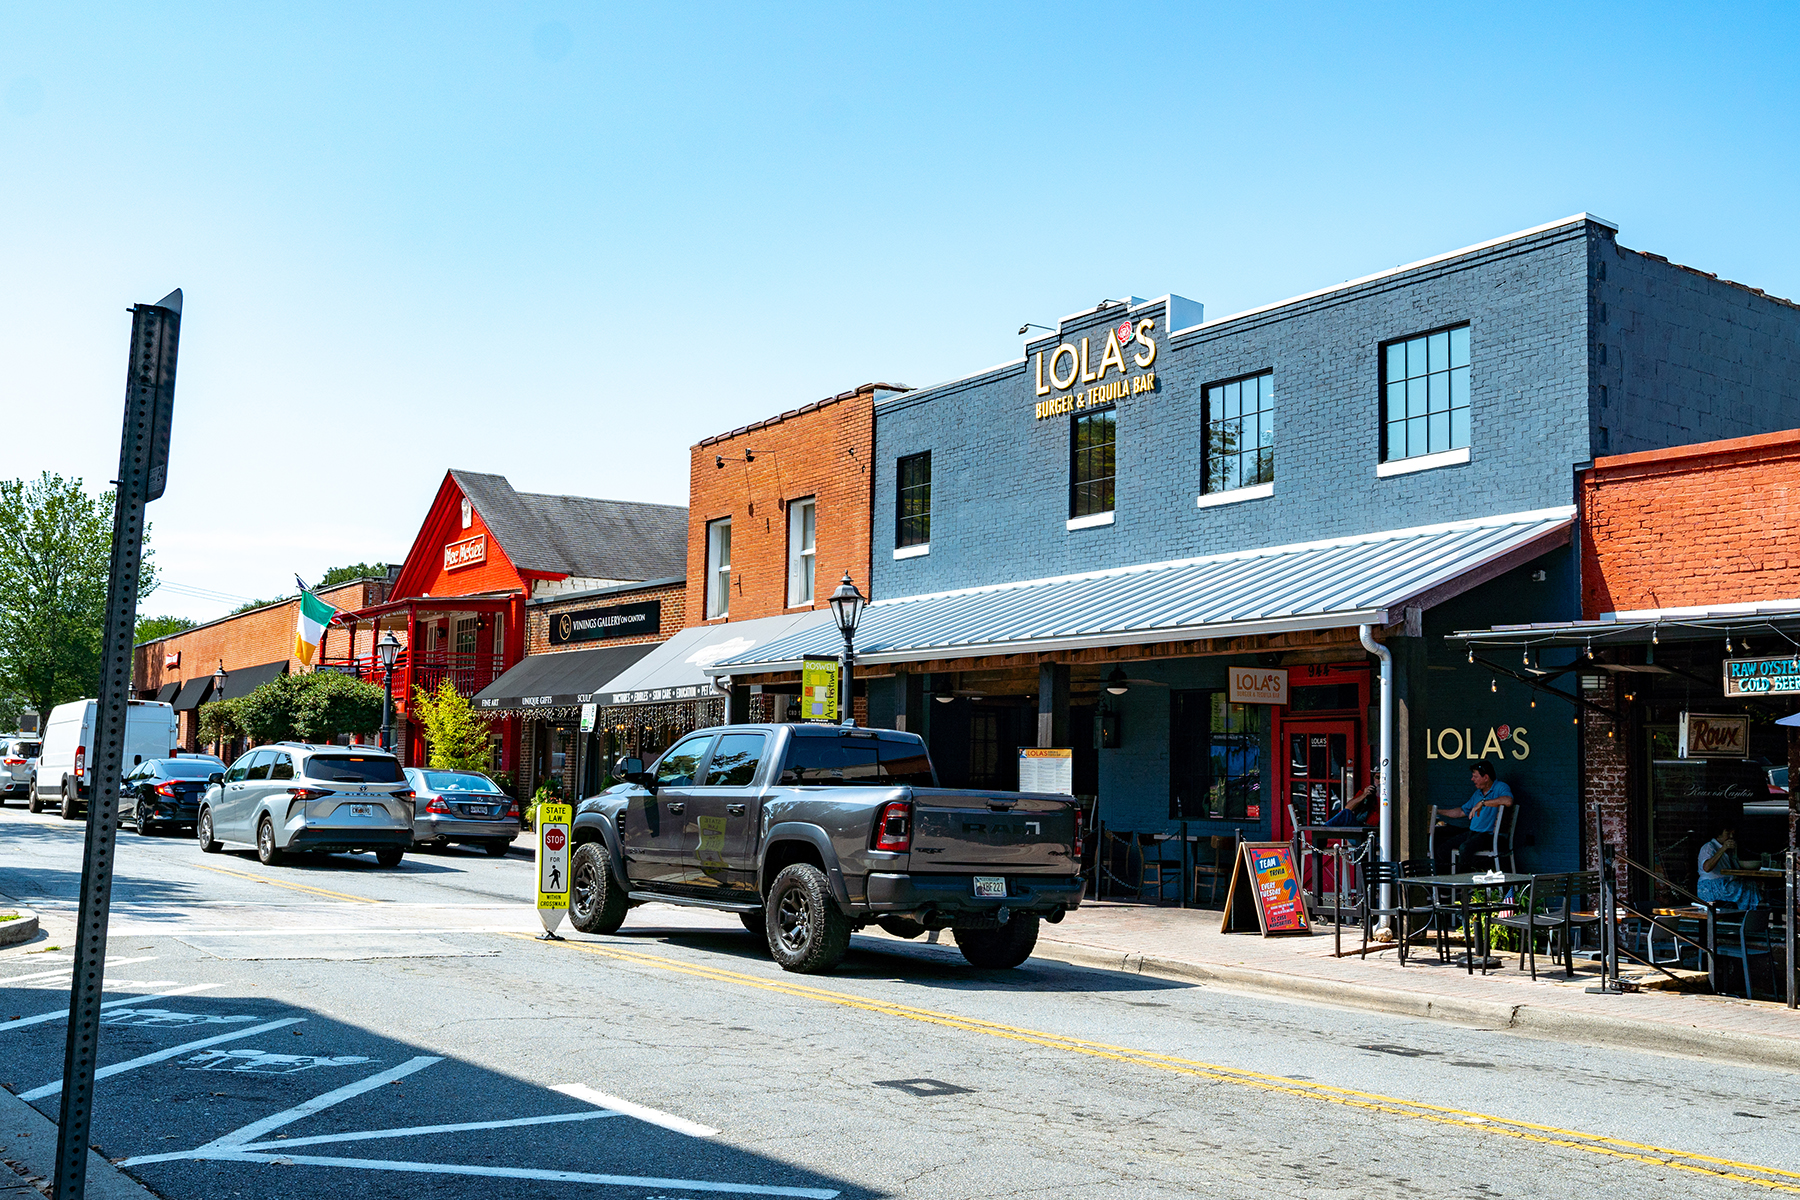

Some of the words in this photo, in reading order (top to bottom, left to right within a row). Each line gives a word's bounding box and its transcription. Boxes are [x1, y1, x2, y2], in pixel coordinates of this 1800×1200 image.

[1035, 318, 1157, 396] LOLA'S
[1035, 395, 1074, 419] BURGER
[1076, 392, 1086, 408] &
[1087, 379, 1131, 406] TEQUILA
[1132, 372, 1156, 394] BAR
[446, 548, 459, 565] Mac
[460, 539, 483, 562] McGee
[573, 618, 597, 631] VININGS
[597, 615, 621, 628] GALLERY
[628, 613, 646, 623] CANTON
[805, 661, 836, 671] ROSWELL
[1731, 662, 1757, 677] RAW
[824, 670, 836, 699] Festival
[1236, 674, 1281, 692] LOLA'S
[1738, 676, 1771, 692] COLD
[652, 689, 662, 700] SKIN
[662, 688, 672, 700] CARE
[701, 685, 710, 696] PET
[481, 699, 491, 707] FINE
[491, 698, 500, 706] ART
[521, 696, 540, 706] UNIQUE
[540, 695, 553, 705] GIFTS
[824, 700, 835, 719] Arts
[1426, 725, 1530, 761] LOLA'S
[1693, 720, 1741, 751] Roux
[545, 806, 566, 815] STATE
[962, 821, 1041, 836] RAM
[546, 835, 565, 844] STOP
[1259, 857, 1276, 869] TEAM
[1269, 867, 1286, 877] TRIVIA
[1260, 887, 1281, 898] TUESDAY
[1261, 881, 1276, 891] EVERY
